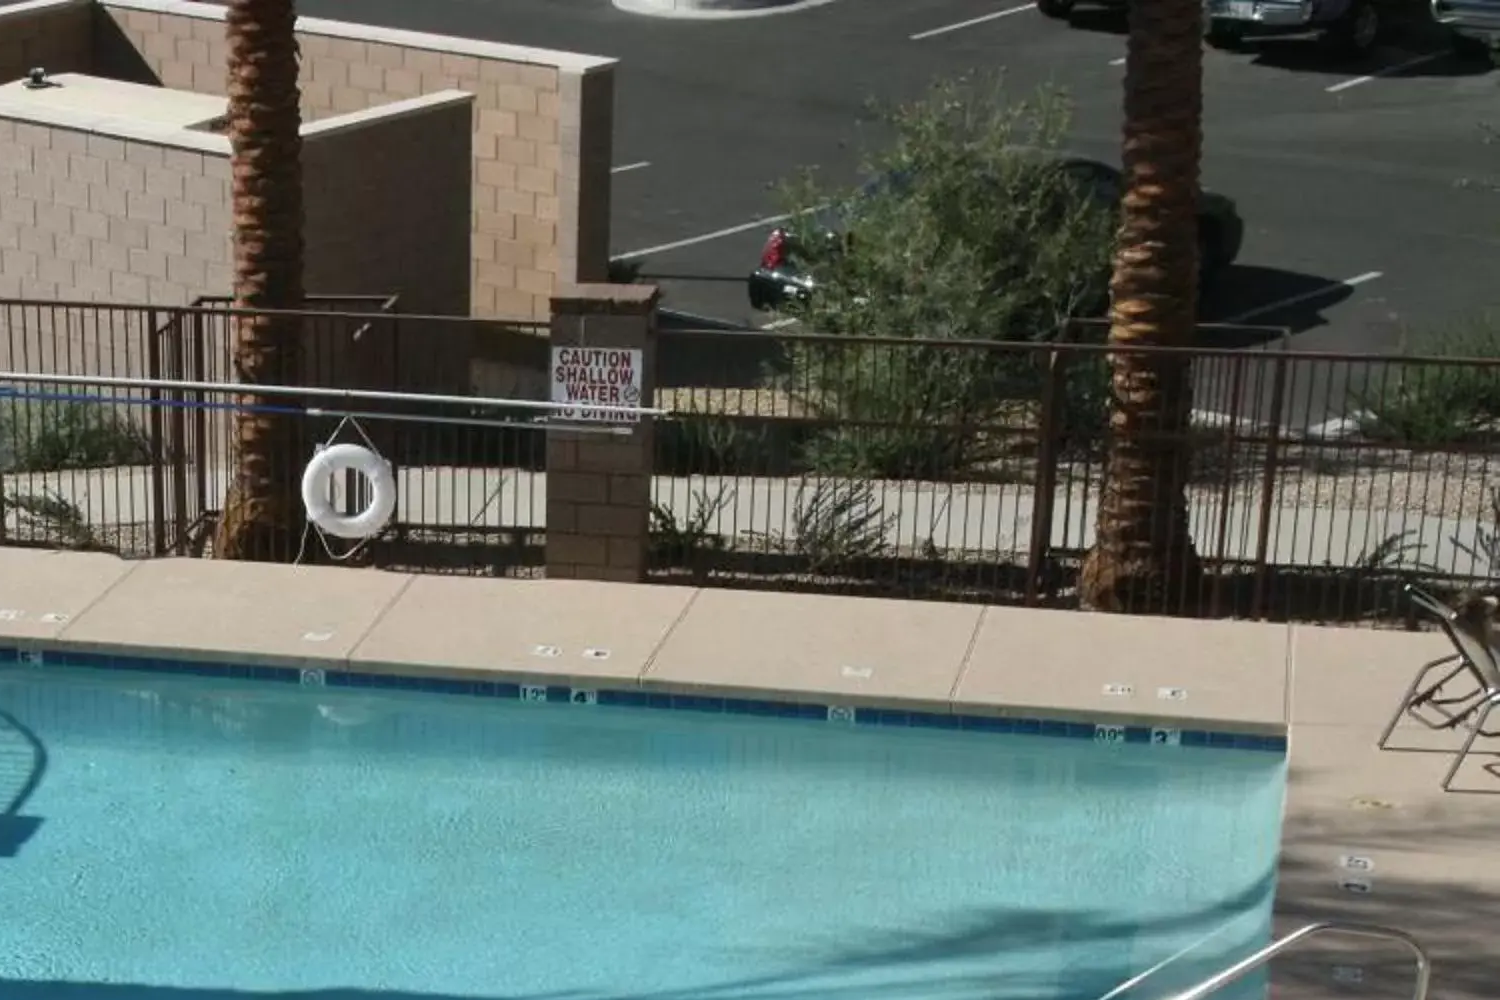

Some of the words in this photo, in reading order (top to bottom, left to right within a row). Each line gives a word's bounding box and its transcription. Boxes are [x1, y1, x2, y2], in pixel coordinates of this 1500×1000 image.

[559, 349, 631, 367] CAUTION
[555, 366, 634, 385] SHALLOW
[565, 383, 620, 402] WATER
